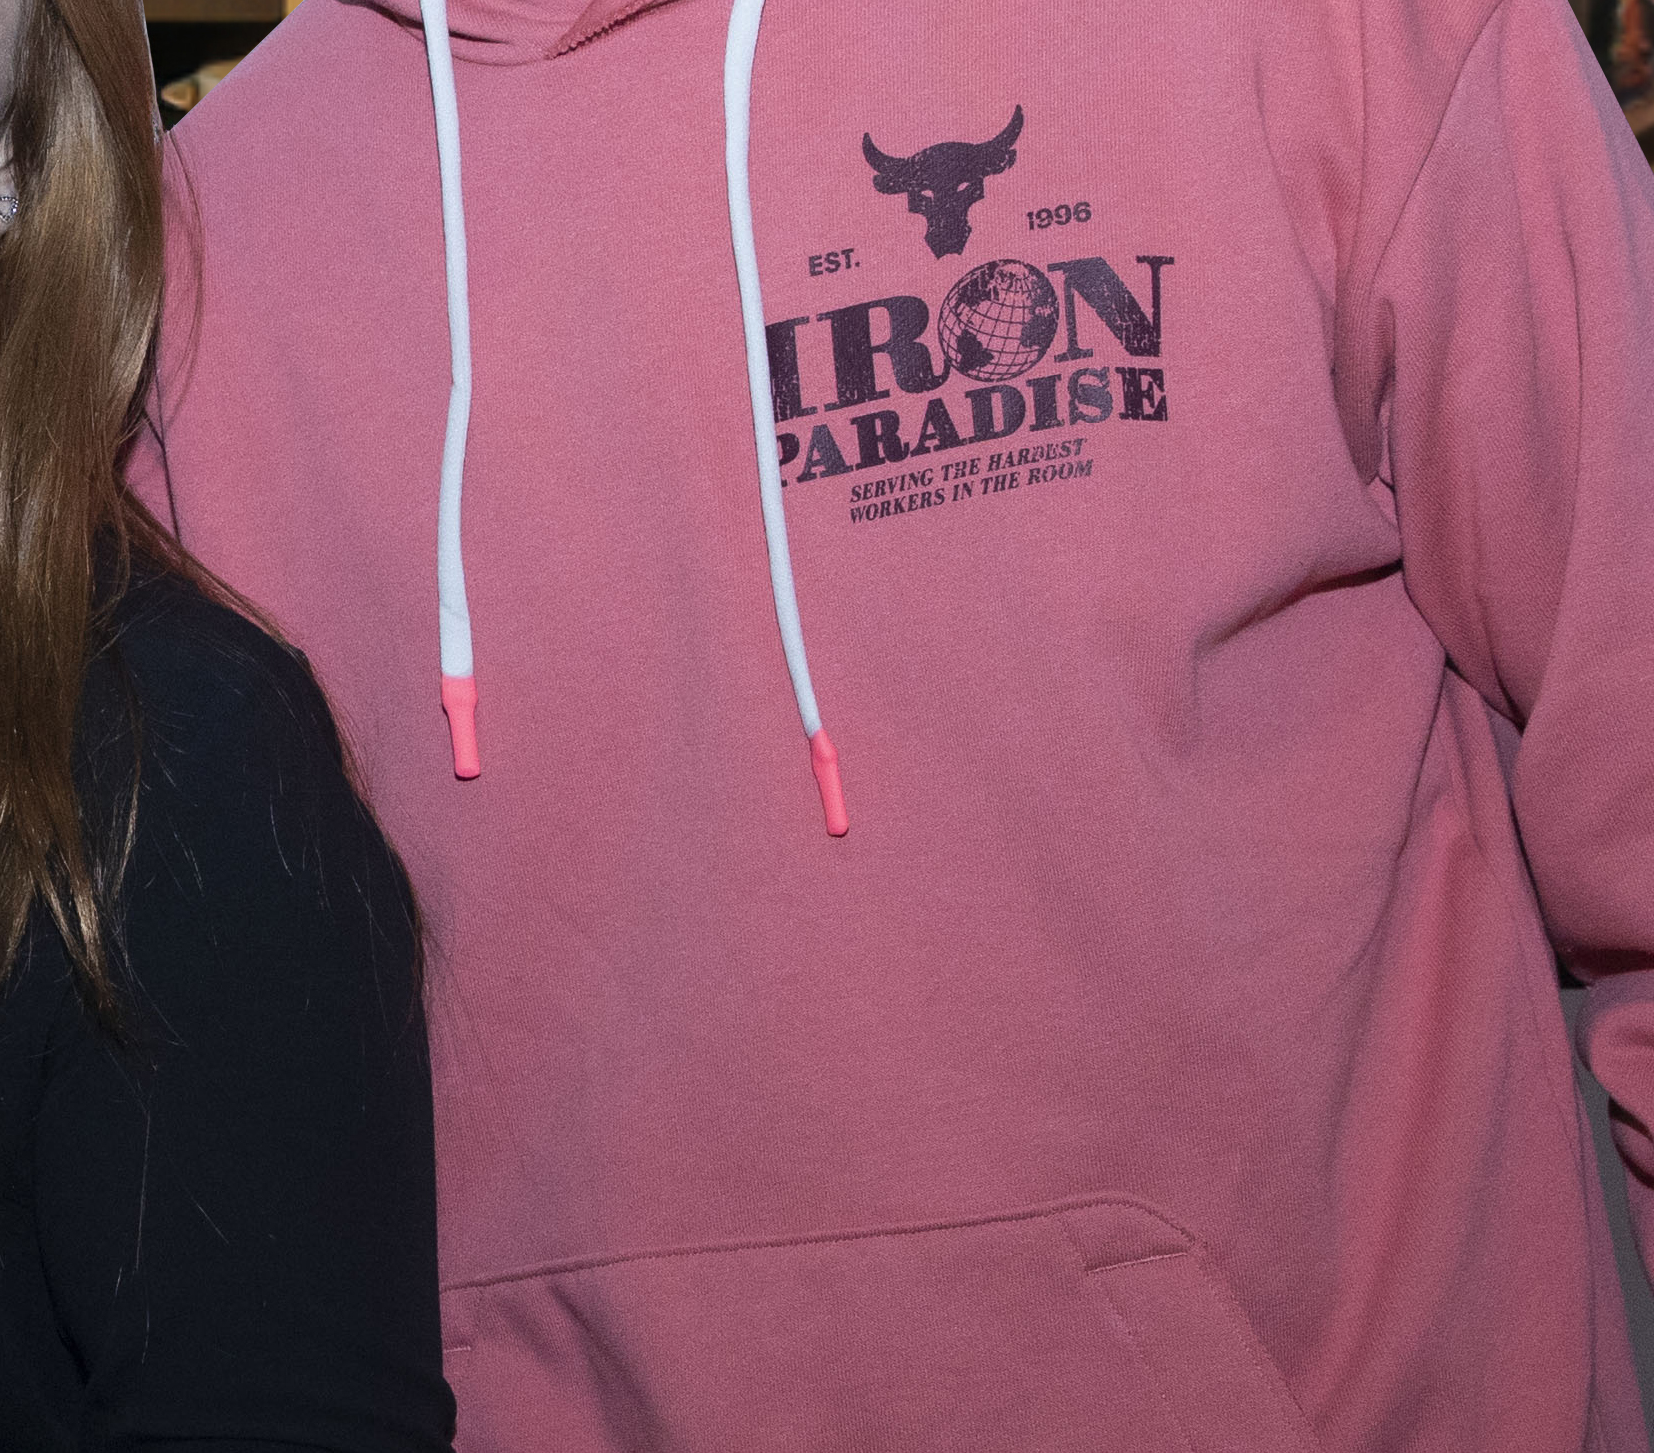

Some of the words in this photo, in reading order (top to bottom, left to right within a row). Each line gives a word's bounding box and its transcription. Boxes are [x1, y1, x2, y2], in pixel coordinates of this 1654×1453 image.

[1027, 201, 1092, 230] 1996
[808, 248, 860, 276] EST.
[765, 255, 1175, 424] IRON
[850, 468, 933, 503] SERVING
[941, 457, 981, 481] THE
[988, 438, 1087, 472] HARDEST
[850, 488, 945, 524] WORKERS
[952, 480, 975, 502] IN
[980, 471, 1020, 496] THE
[1028, 459, 1093, 485] ROOM
